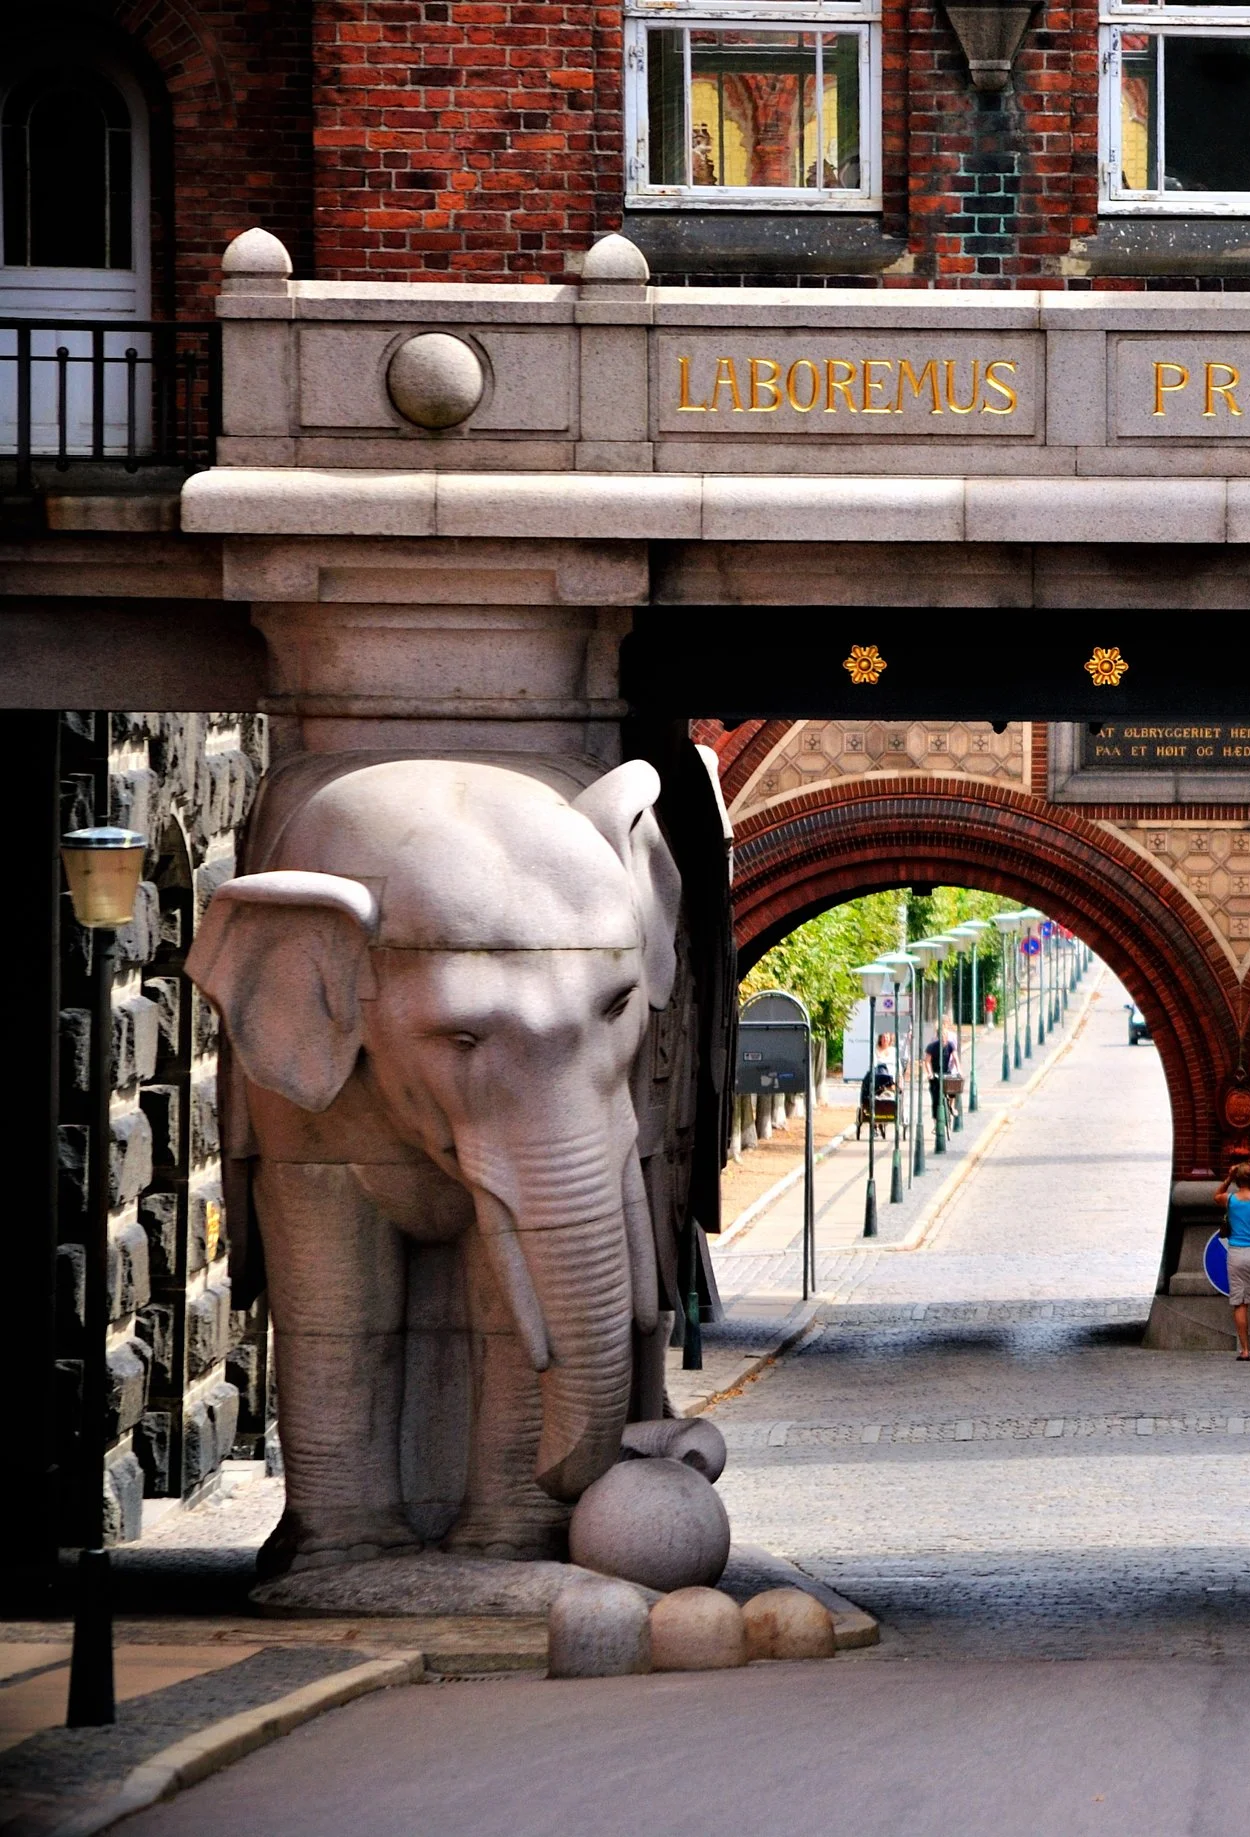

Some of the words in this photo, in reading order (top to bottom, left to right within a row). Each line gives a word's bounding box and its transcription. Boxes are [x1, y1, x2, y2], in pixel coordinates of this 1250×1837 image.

[676, 356, 1018, 415] LABOREMUS
[1124, 727, 1222, 739] ØLBRYGGERIET
[1095, 746, 1122, 757] PAA
[1131, 746, 1148, 757] ET
[1155, 746, 1187, 757] HØIT
[1196, 746, 1214, 757] OG
